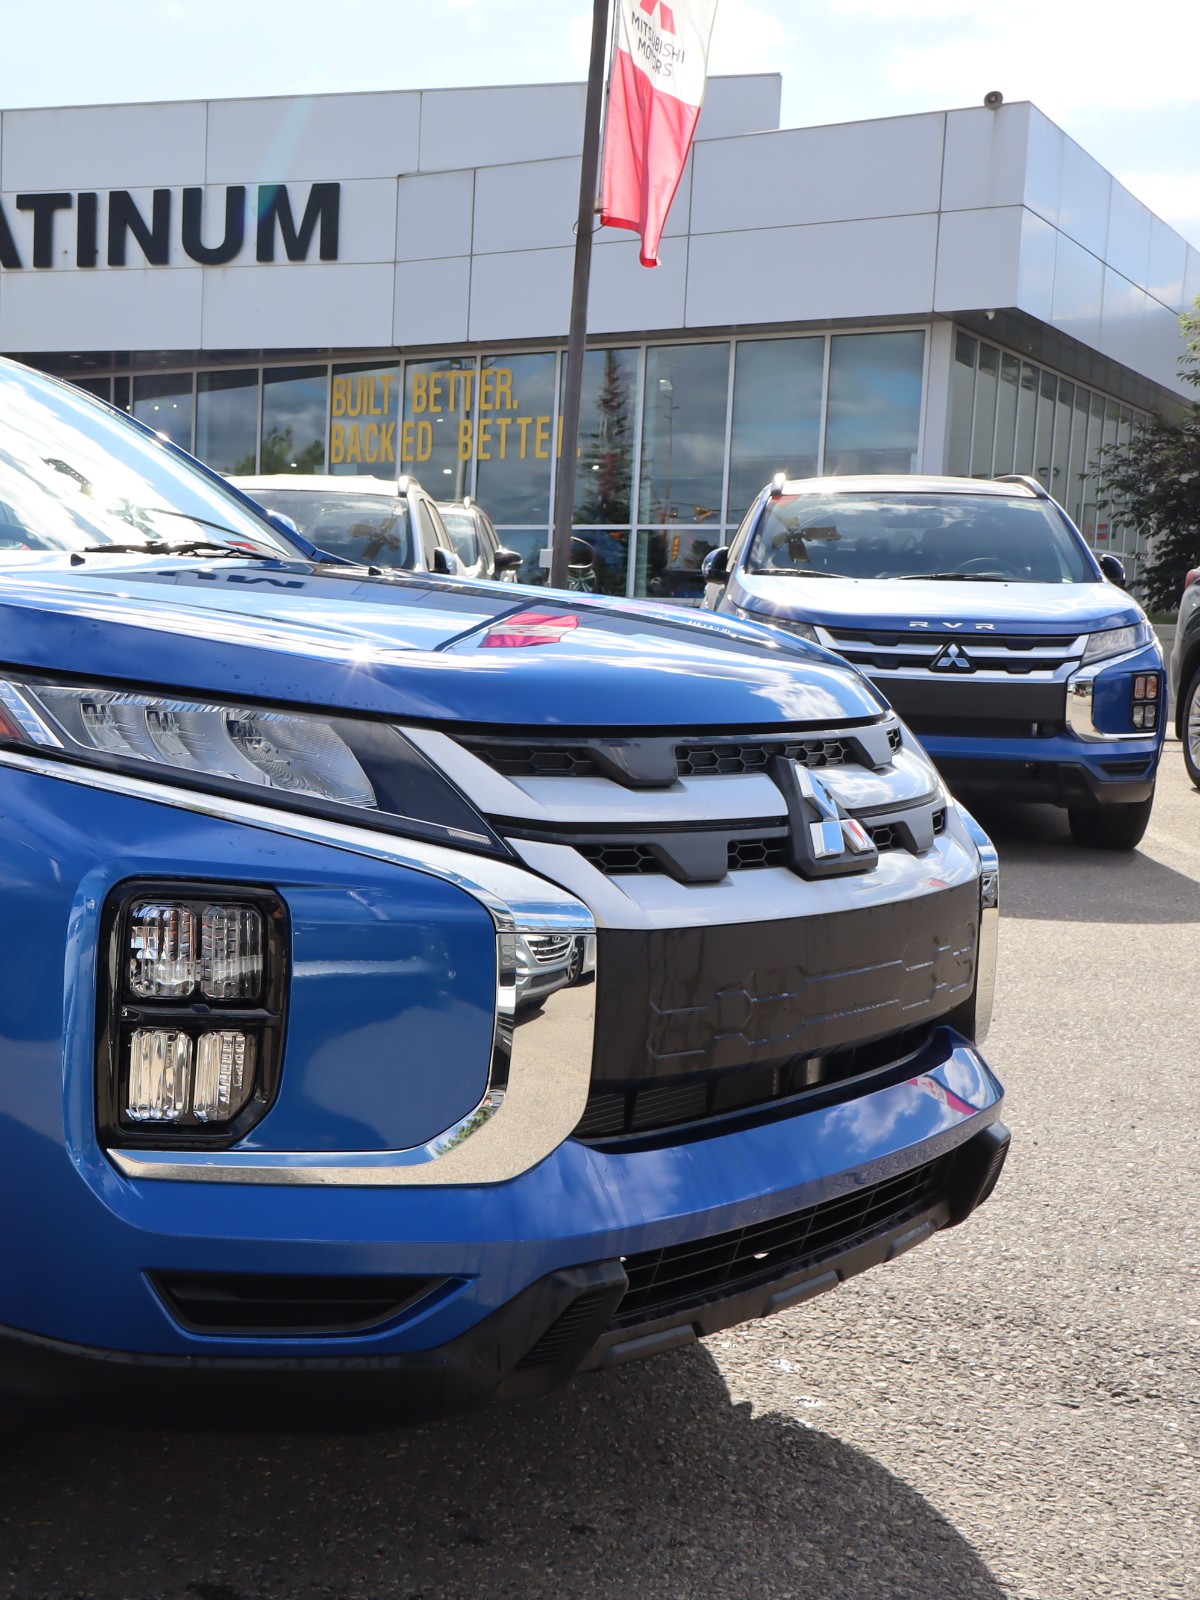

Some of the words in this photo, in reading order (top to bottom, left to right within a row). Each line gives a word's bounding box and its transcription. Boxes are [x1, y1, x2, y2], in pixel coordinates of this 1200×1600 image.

[631, 10, 685, 64] MITSUBISHI
[332, 374, 396, 418] BUILT
[411, 368, 520, 414] BETTER.
[330, 420, 434, 464] BACKED
[457, 415, 581, 462] BETTE.
[909, 620, 996, 631] RVR
